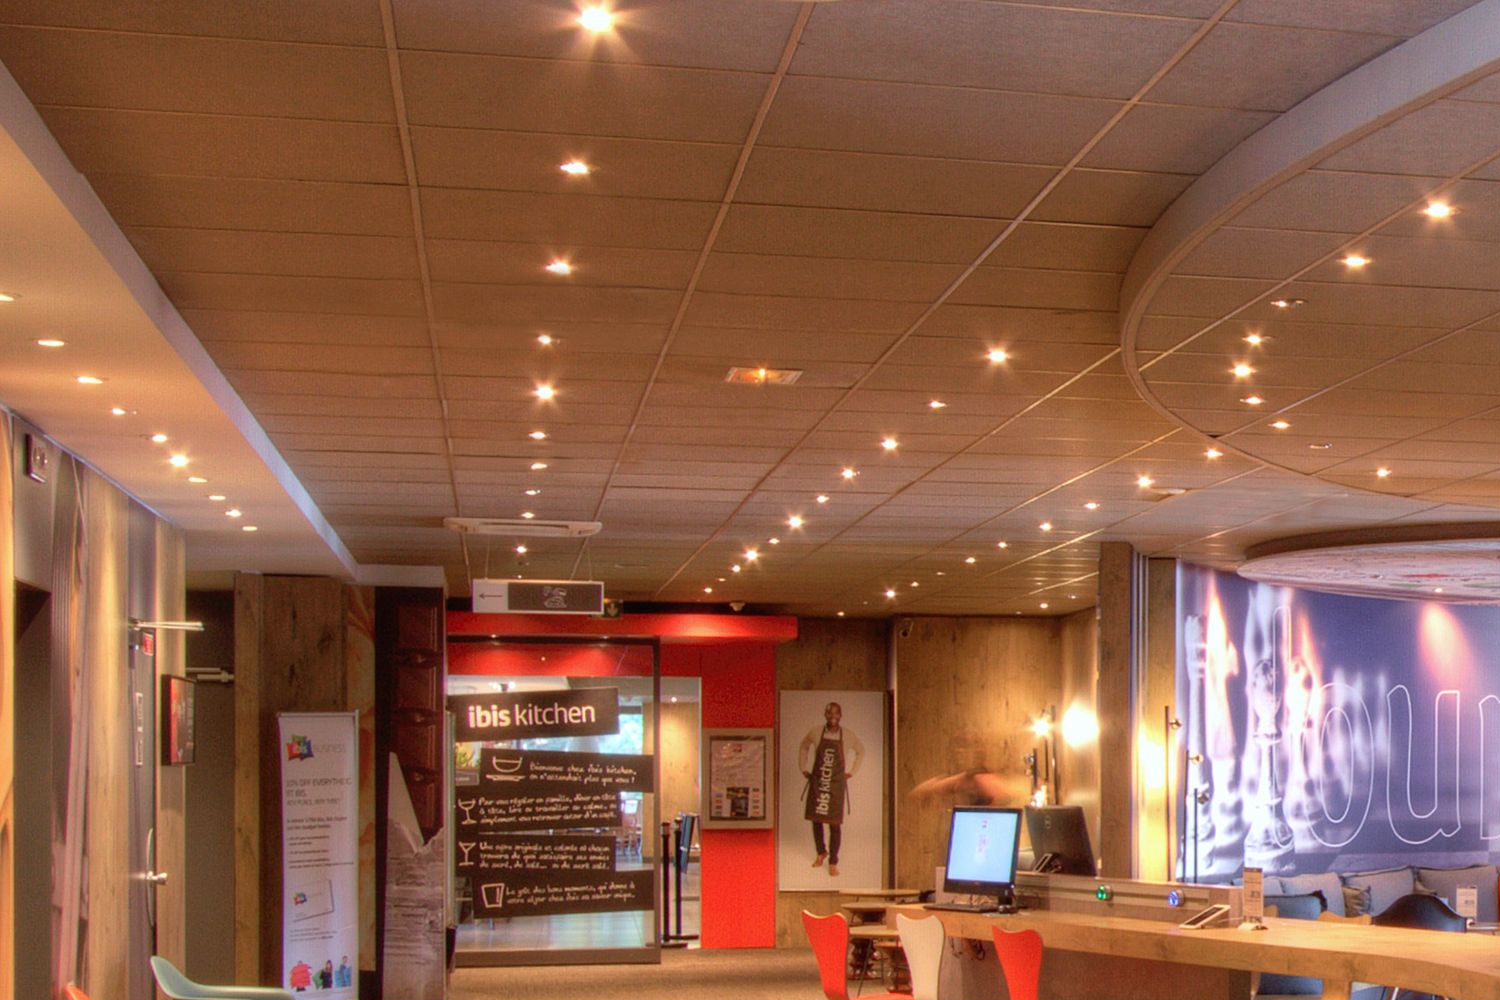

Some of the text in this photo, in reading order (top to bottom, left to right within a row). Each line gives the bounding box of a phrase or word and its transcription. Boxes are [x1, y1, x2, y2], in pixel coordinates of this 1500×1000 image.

[468, 702, 596, 728] ibis kitchen
[816, 748, 836, 816] ibis kitchen
